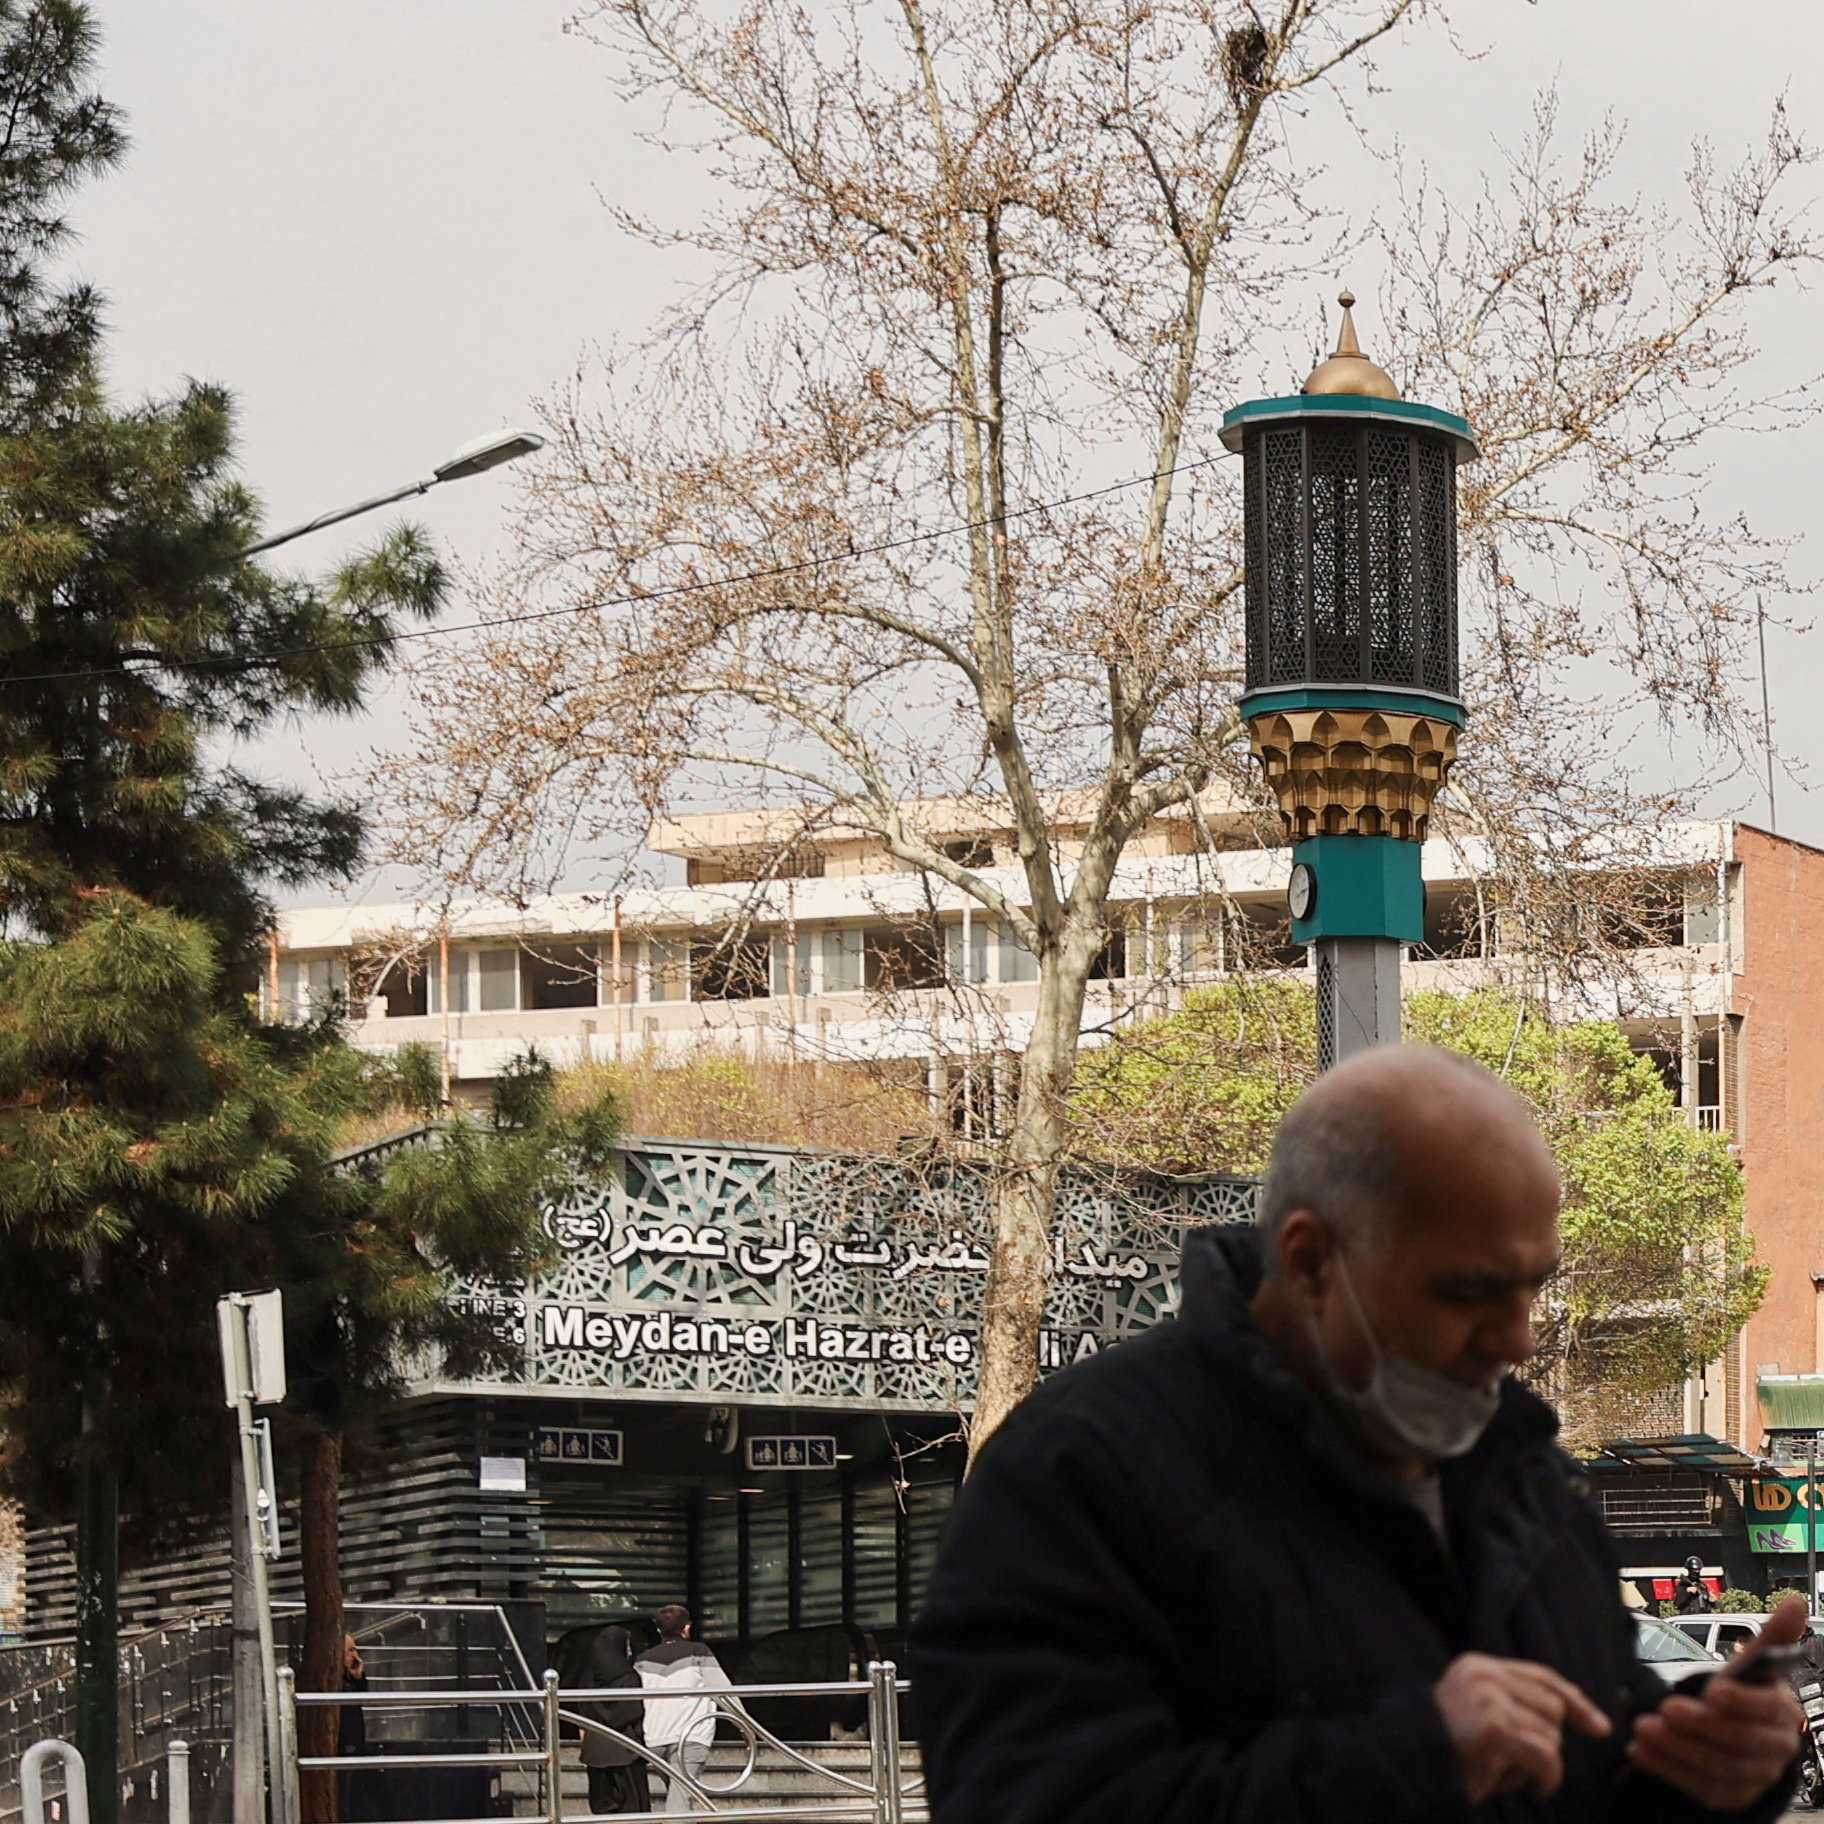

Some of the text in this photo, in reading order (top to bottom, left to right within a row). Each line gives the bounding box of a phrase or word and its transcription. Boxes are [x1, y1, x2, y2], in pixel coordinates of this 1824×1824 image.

[609, 1223, 727, 1266] عصر
[743, 1220, 823, 1277] ولی
[1046, 1235, 1149, 1289] میدا
[513, 1301, 526, 1318] 3
[544, 1305, 772, 1358] Meydan-e
[786, 1318, 972, 1363] Hazrat-e
